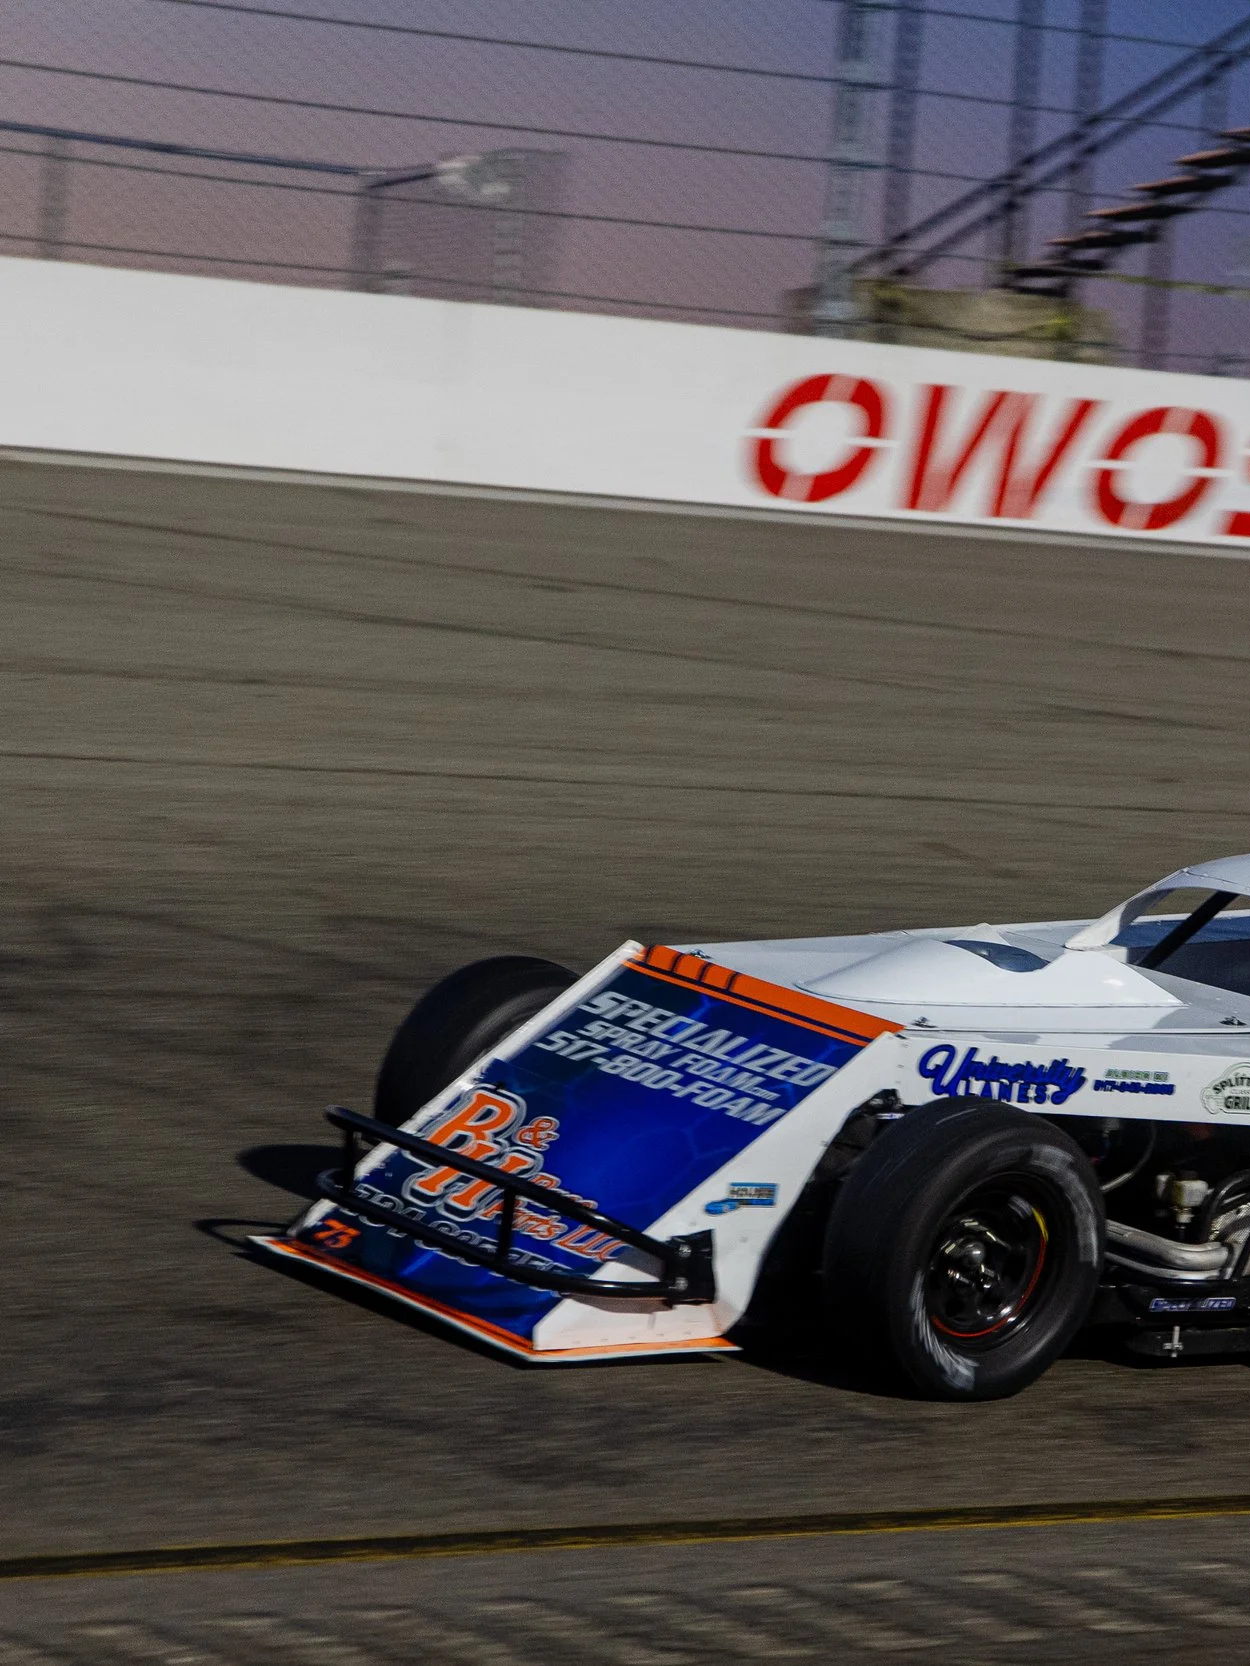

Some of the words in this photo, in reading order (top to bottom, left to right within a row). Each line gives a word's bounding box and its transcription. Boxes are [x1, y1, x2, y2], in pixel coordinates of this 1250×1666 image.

[576, 1019, 682, 1061] SPRAY
[577, 991, 839, 1087] SPECIALIZED
[532, 1030, 788, 1126] 517-800-FOAM
[313, 1218, 361, 1248] 73
